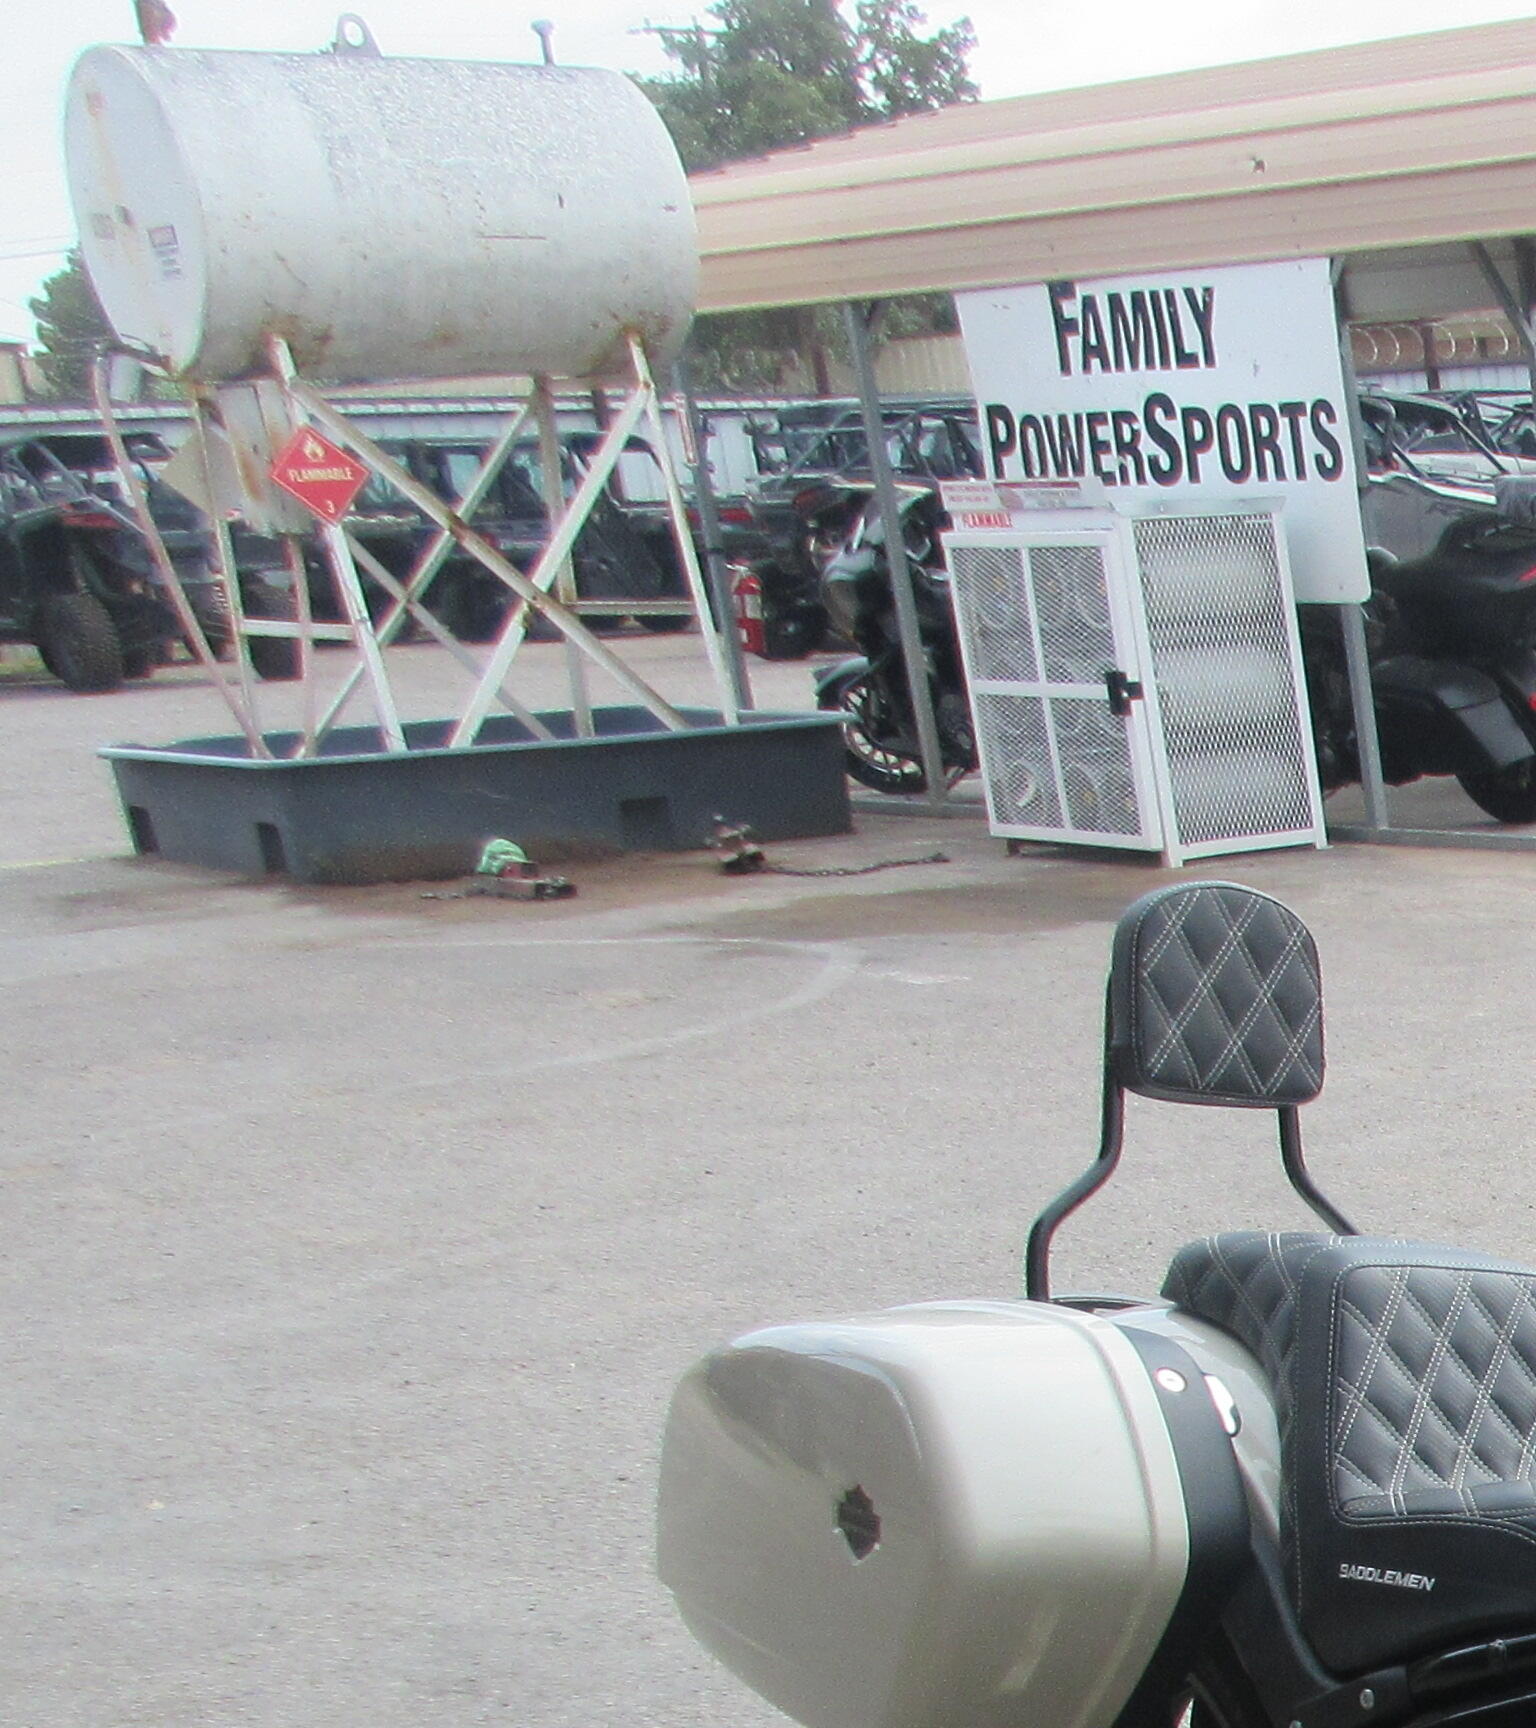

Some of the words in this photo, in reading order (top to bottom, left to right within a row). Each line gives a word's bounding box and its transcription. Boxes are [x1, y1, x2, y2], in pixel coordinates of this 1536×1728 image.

[1049, 281, 1217, 377] FAMILY
[986, 392, 1344, 488] POWERSPORTS
[287, 466, 354, 483] FLAMMABLE
[326, 500, 336, 514] 3
[1339, 1563, 1436, 1592] SADDLEMEN
